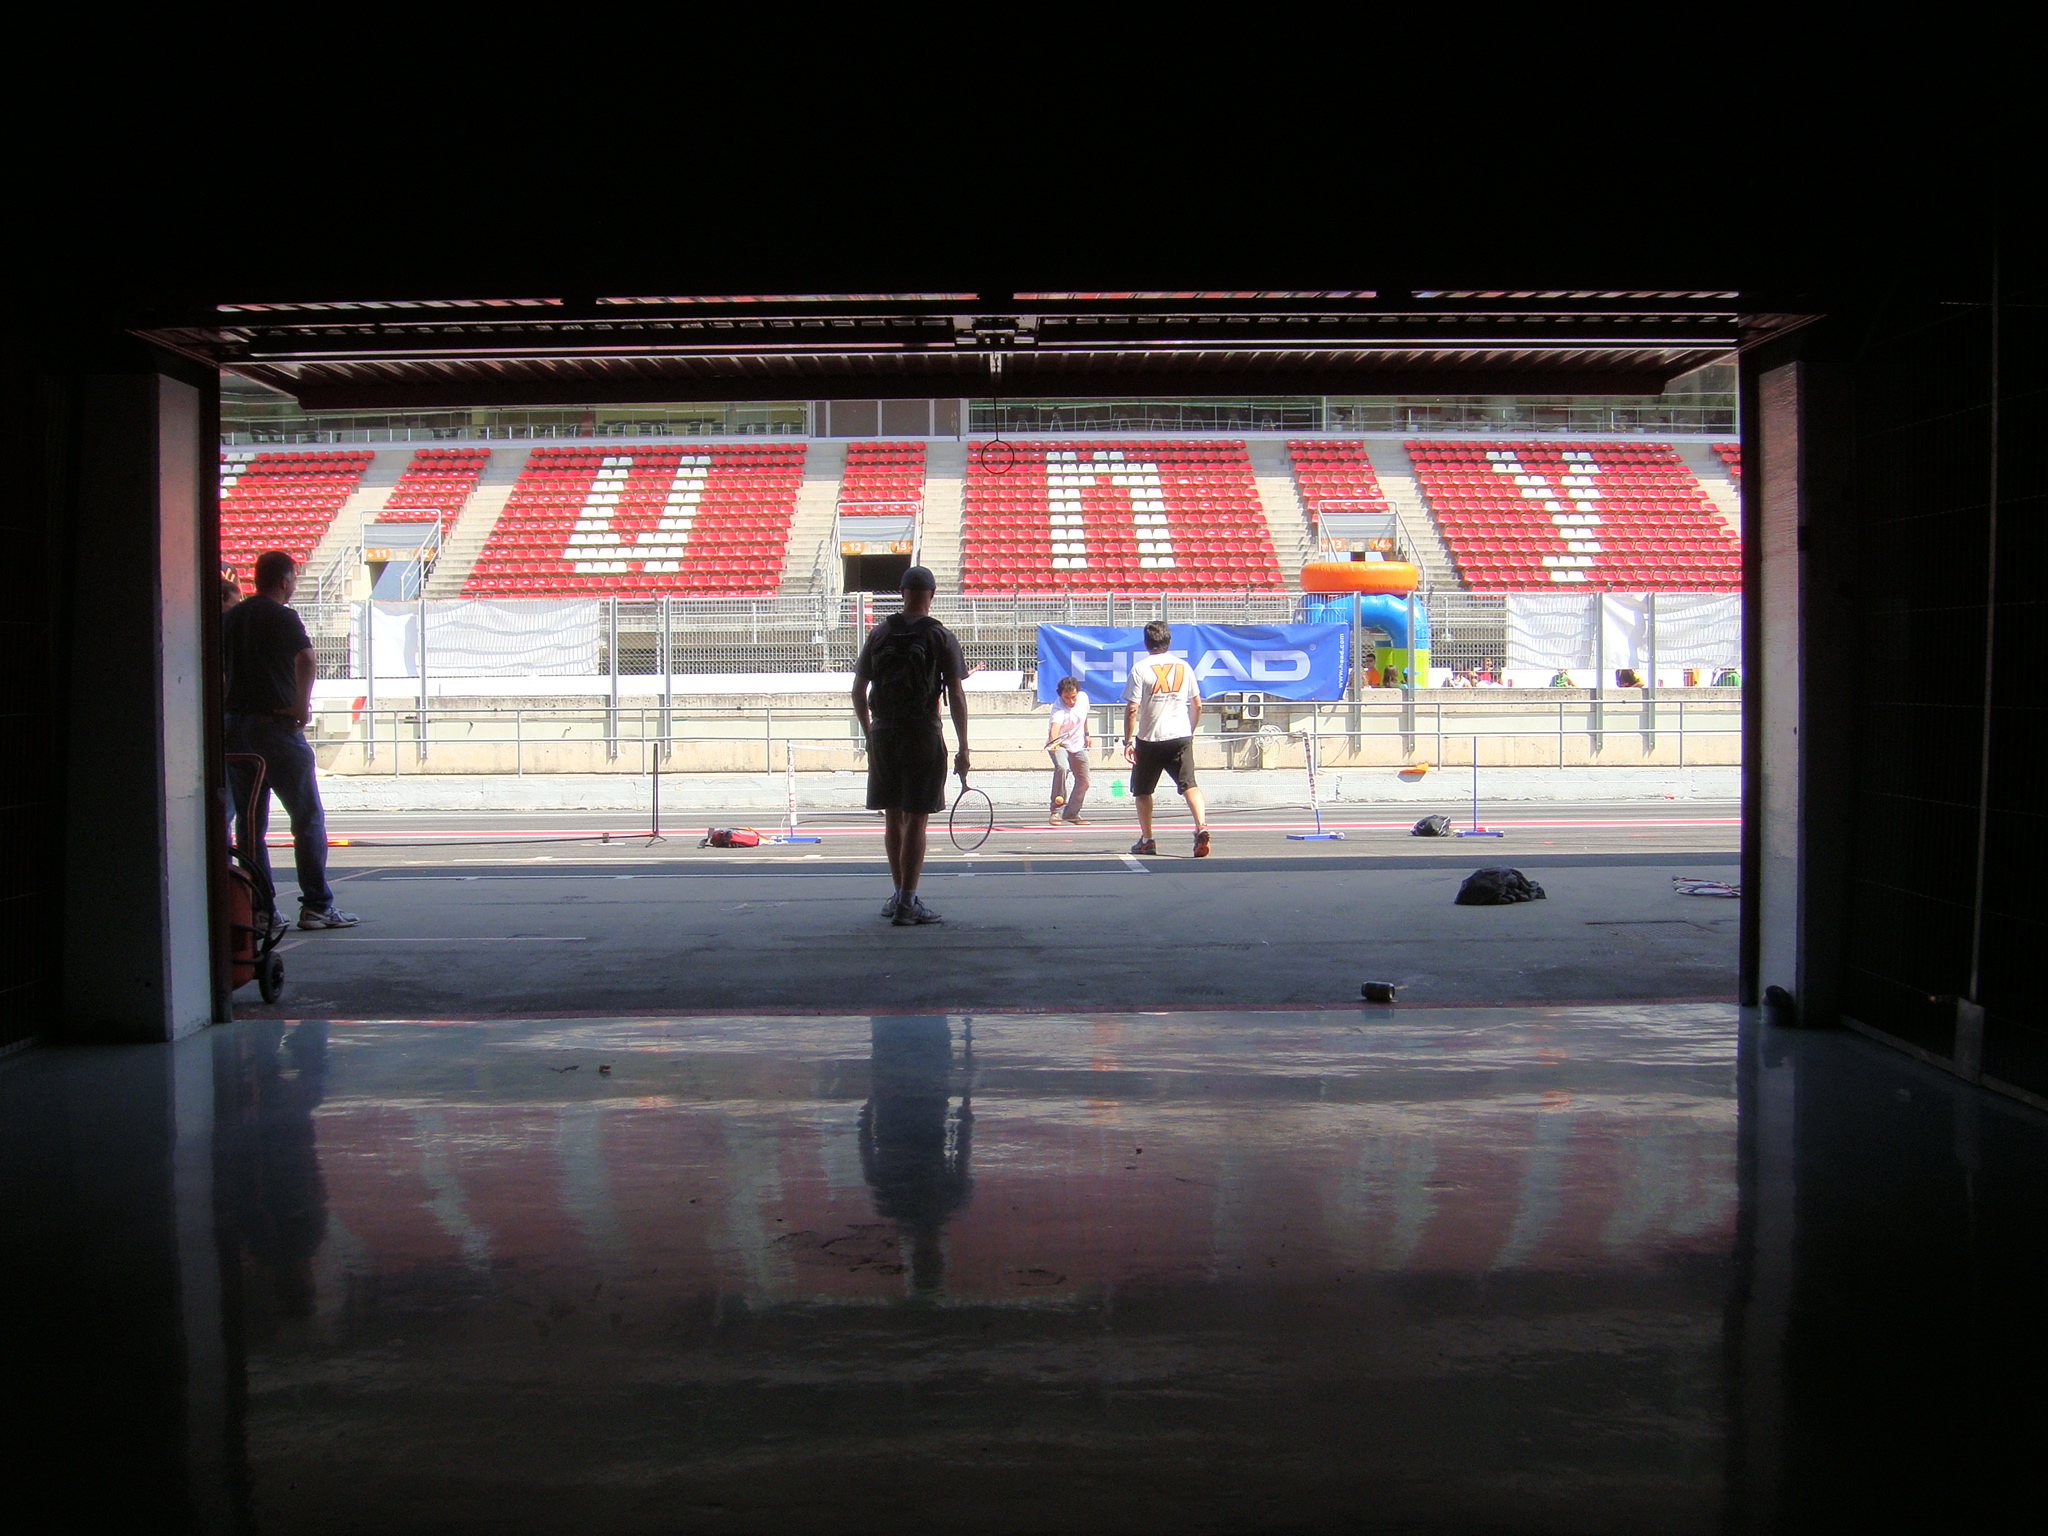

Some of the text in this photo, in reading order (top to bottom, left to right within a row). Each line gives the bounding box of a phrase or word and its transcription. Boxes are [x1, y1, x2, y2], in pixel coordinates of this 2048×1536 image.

[849, 543, 862, 552] 12
[894, 542, 907, 551] 13
[1373, 540, 1385, 549] 14
[374, 549, 387, 558] 11
[1150, 663, 1185, 694] XI
